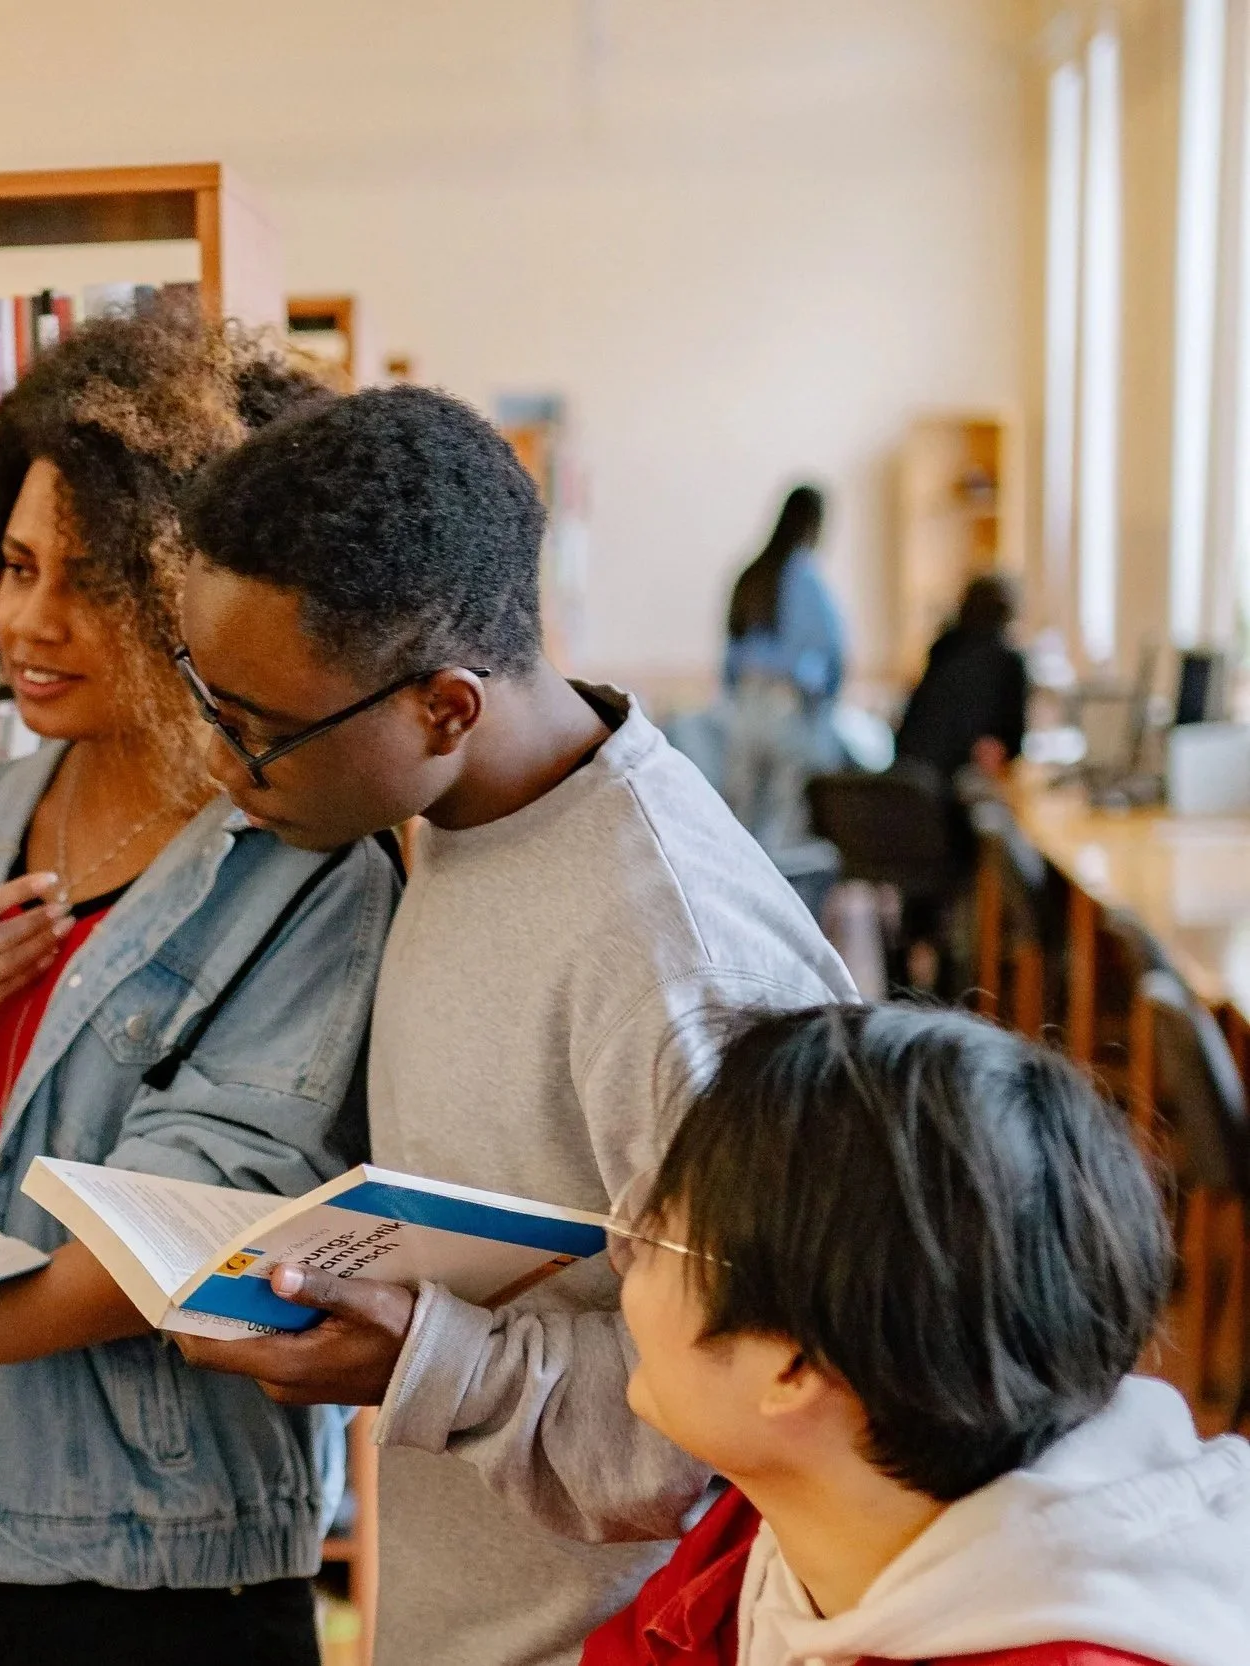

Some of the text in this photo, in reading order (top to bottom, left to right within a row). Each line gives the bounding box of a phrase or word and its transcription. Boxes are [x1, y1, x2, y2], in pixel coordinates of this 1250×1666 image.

[298, 1230, 357, 1265] ungs-
[320, 1221, 407, 1270] ammatik
[338, 1243, 401, 1279] eutsch
